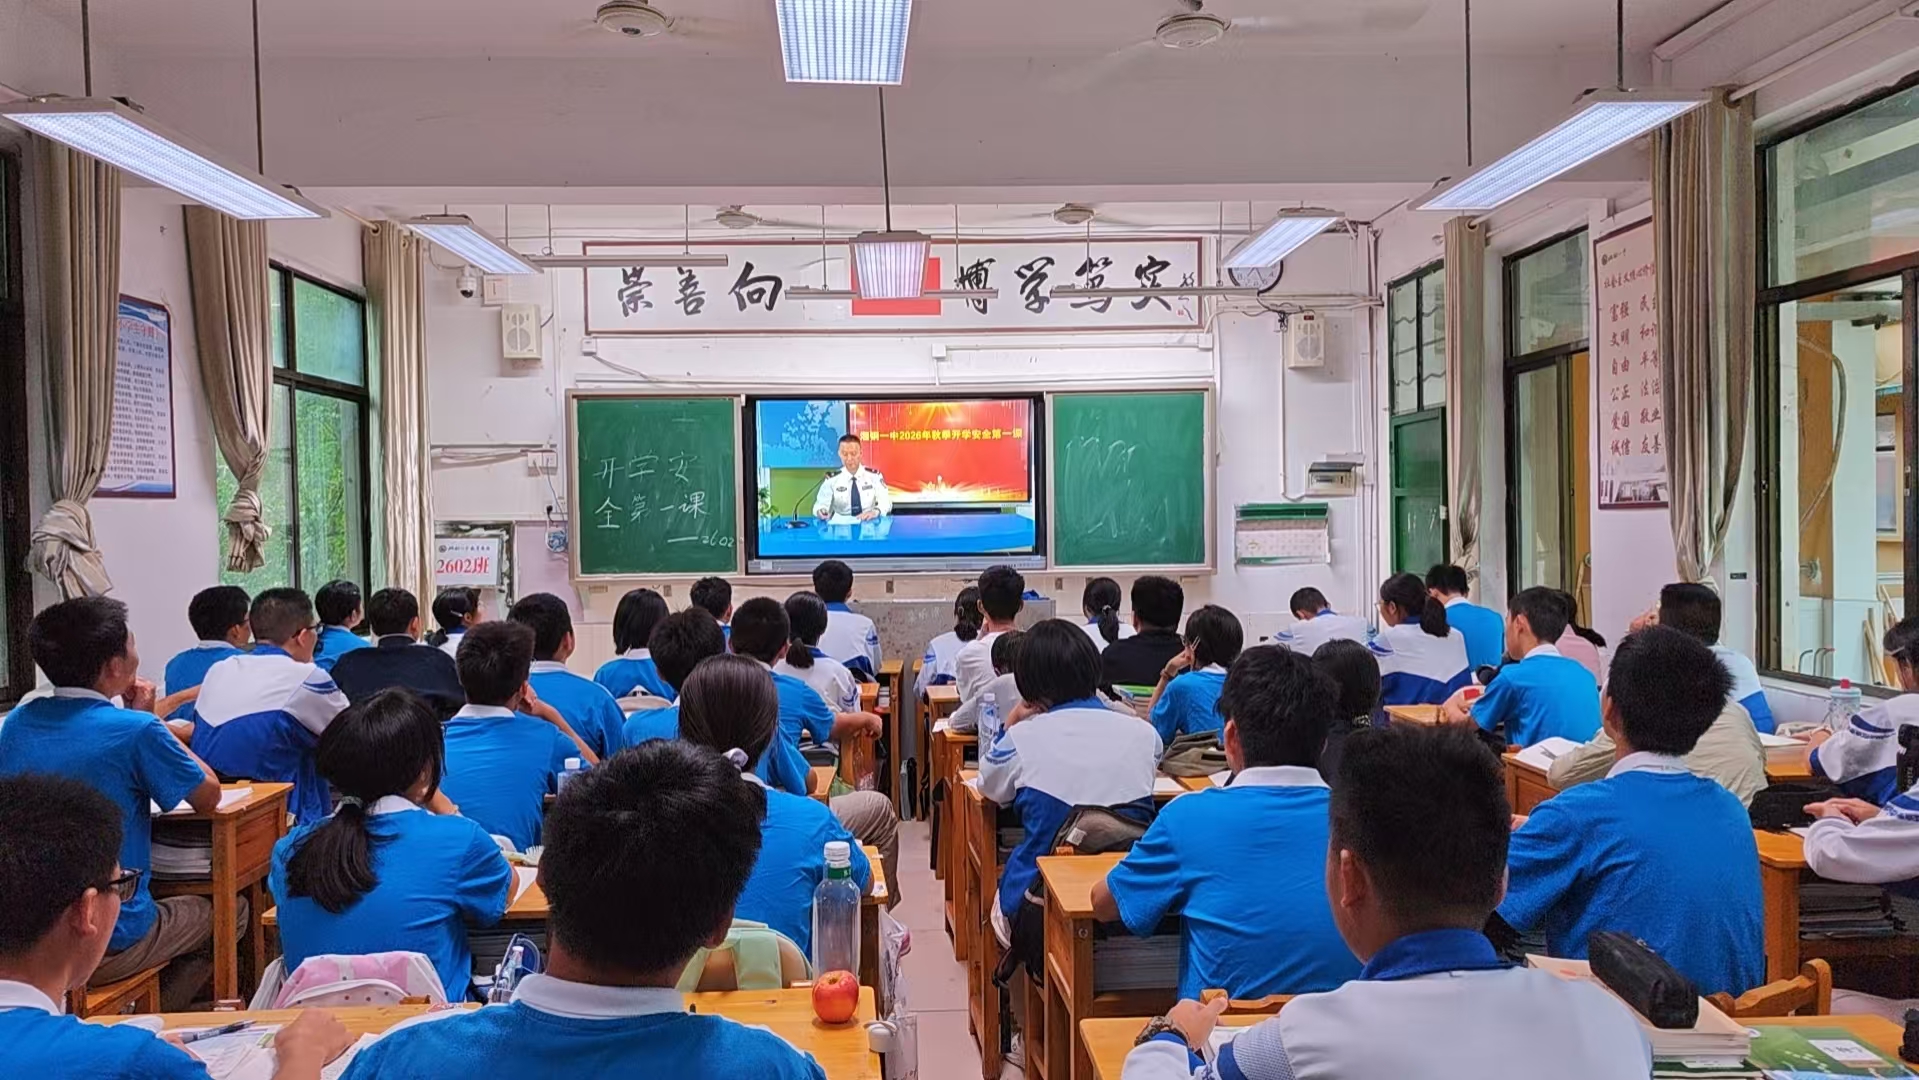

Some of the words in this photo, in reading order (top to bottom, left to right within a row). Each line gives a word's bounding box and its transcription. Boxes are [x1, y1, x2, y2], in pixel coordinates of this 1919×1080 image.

[1610, 301, 1629, 322] 富强
[1610, 328, 1629, 347] 文明
[1611, 356, 1630, 375] 自由
[1610, 384, 1630, 401] 公正
[1640, 377, 1661, 398] 法治
[1611, 410, 1630, 430] 爱国
[1640, 407, 1661, 424] 敬业
[1611, 439, 1631, 456] 诚信
[1640, 432, 1661, 454] 友善
[593, 450, 697, 489] 开学安
[595, 491, 709, 528] 全第一课
[436, 556, 489, 574] 2602班
